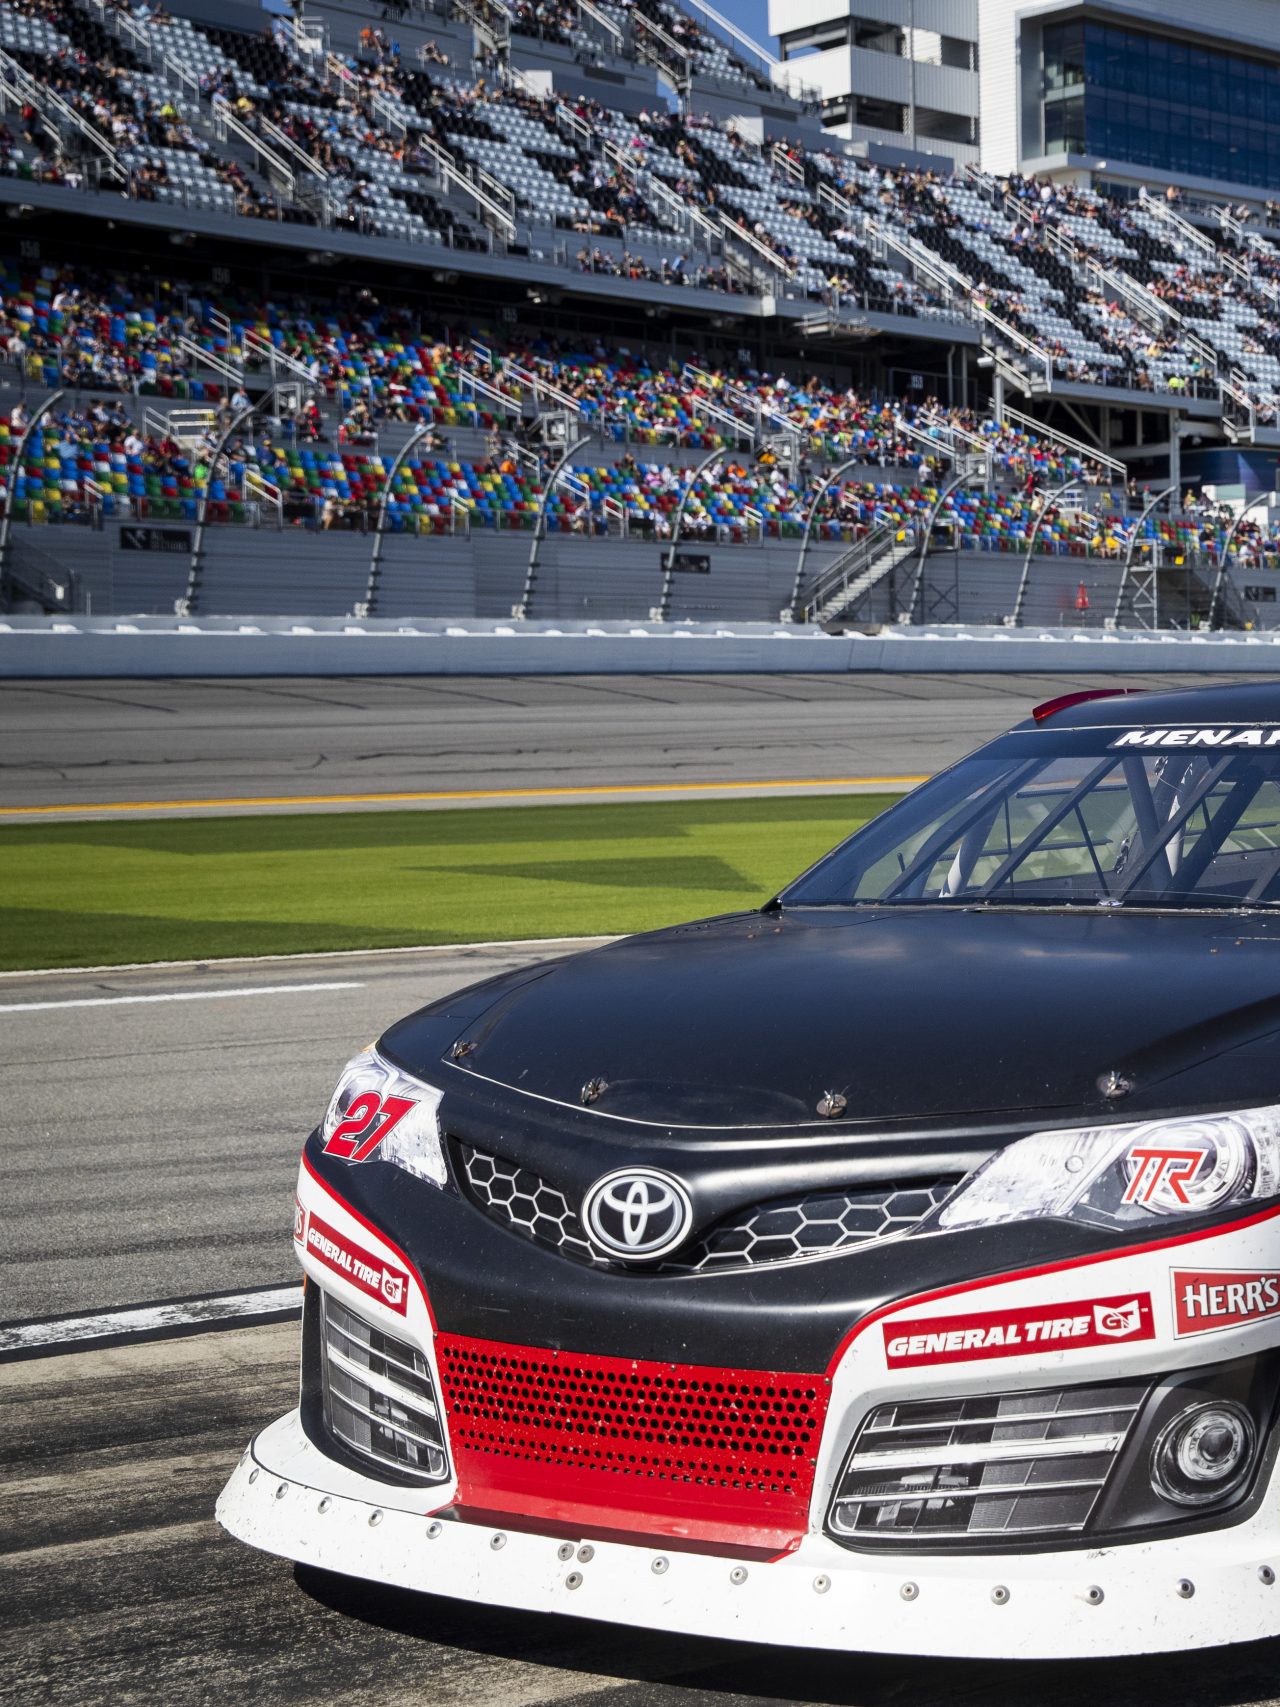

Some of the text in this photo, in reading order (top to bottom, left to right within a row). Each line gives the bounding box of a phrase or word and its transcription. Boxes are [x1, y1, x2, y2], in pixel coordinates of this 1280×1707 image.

[323, 1090, 421, 1163] 27
[1121, 1147, 1210, 1205] TR
[308, 1227, 353, 1275] GENERAL
[352, 1258, 382, 1290] TIRE
[1181, 1275, 1280, 1319] HERR'S
[887, 1324, 1022, 1358] GENERAL
[1024, 1315, 1092, 1342] TIRE
